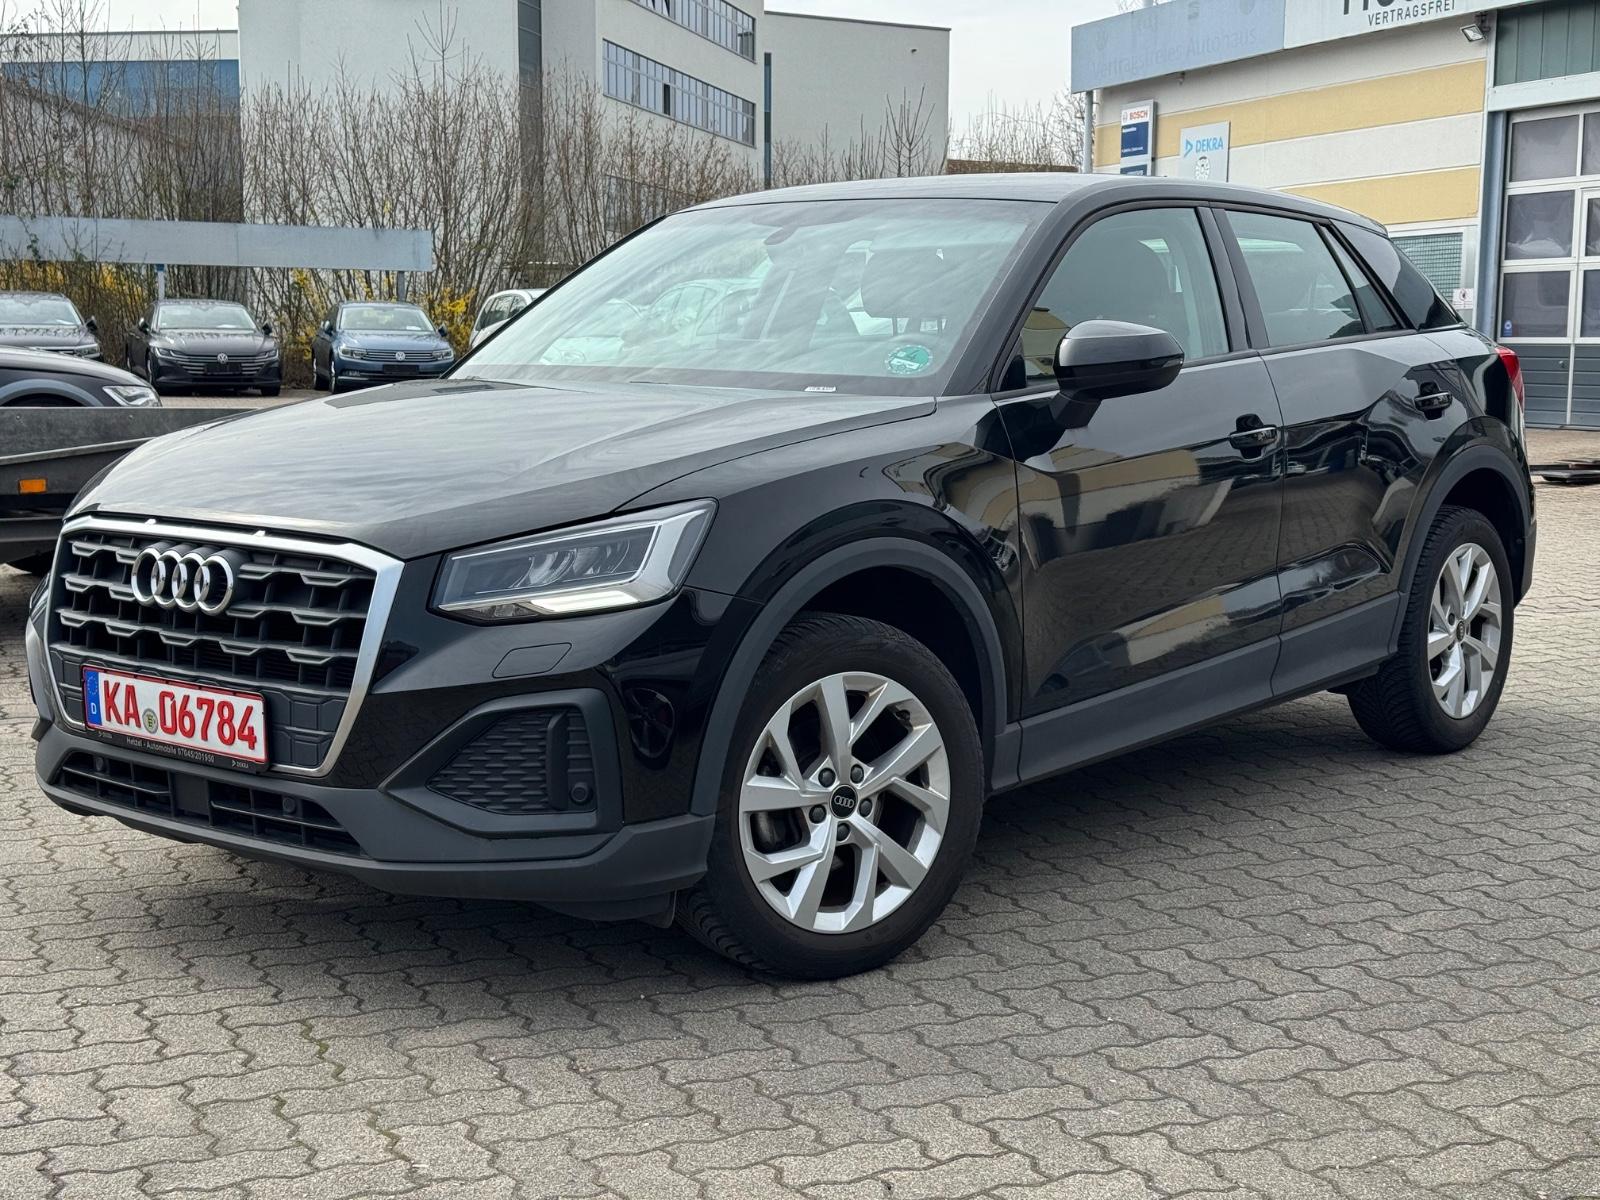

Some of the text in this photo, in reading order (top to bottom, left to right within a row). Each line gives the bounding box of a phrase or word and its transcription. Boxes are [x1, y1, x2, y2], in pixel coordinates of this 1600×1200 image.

[1367, 0, 1455, 26] VERTRAGSFREI
[1186, 28, 1257, 57] Autohaus
[1129, 110, 1148, 120] BOSCH
[1195, 136, 1224, 154] DEKRA
[90, 702, 97, 715] D
[103, 680, 257, 750] KA 06784
